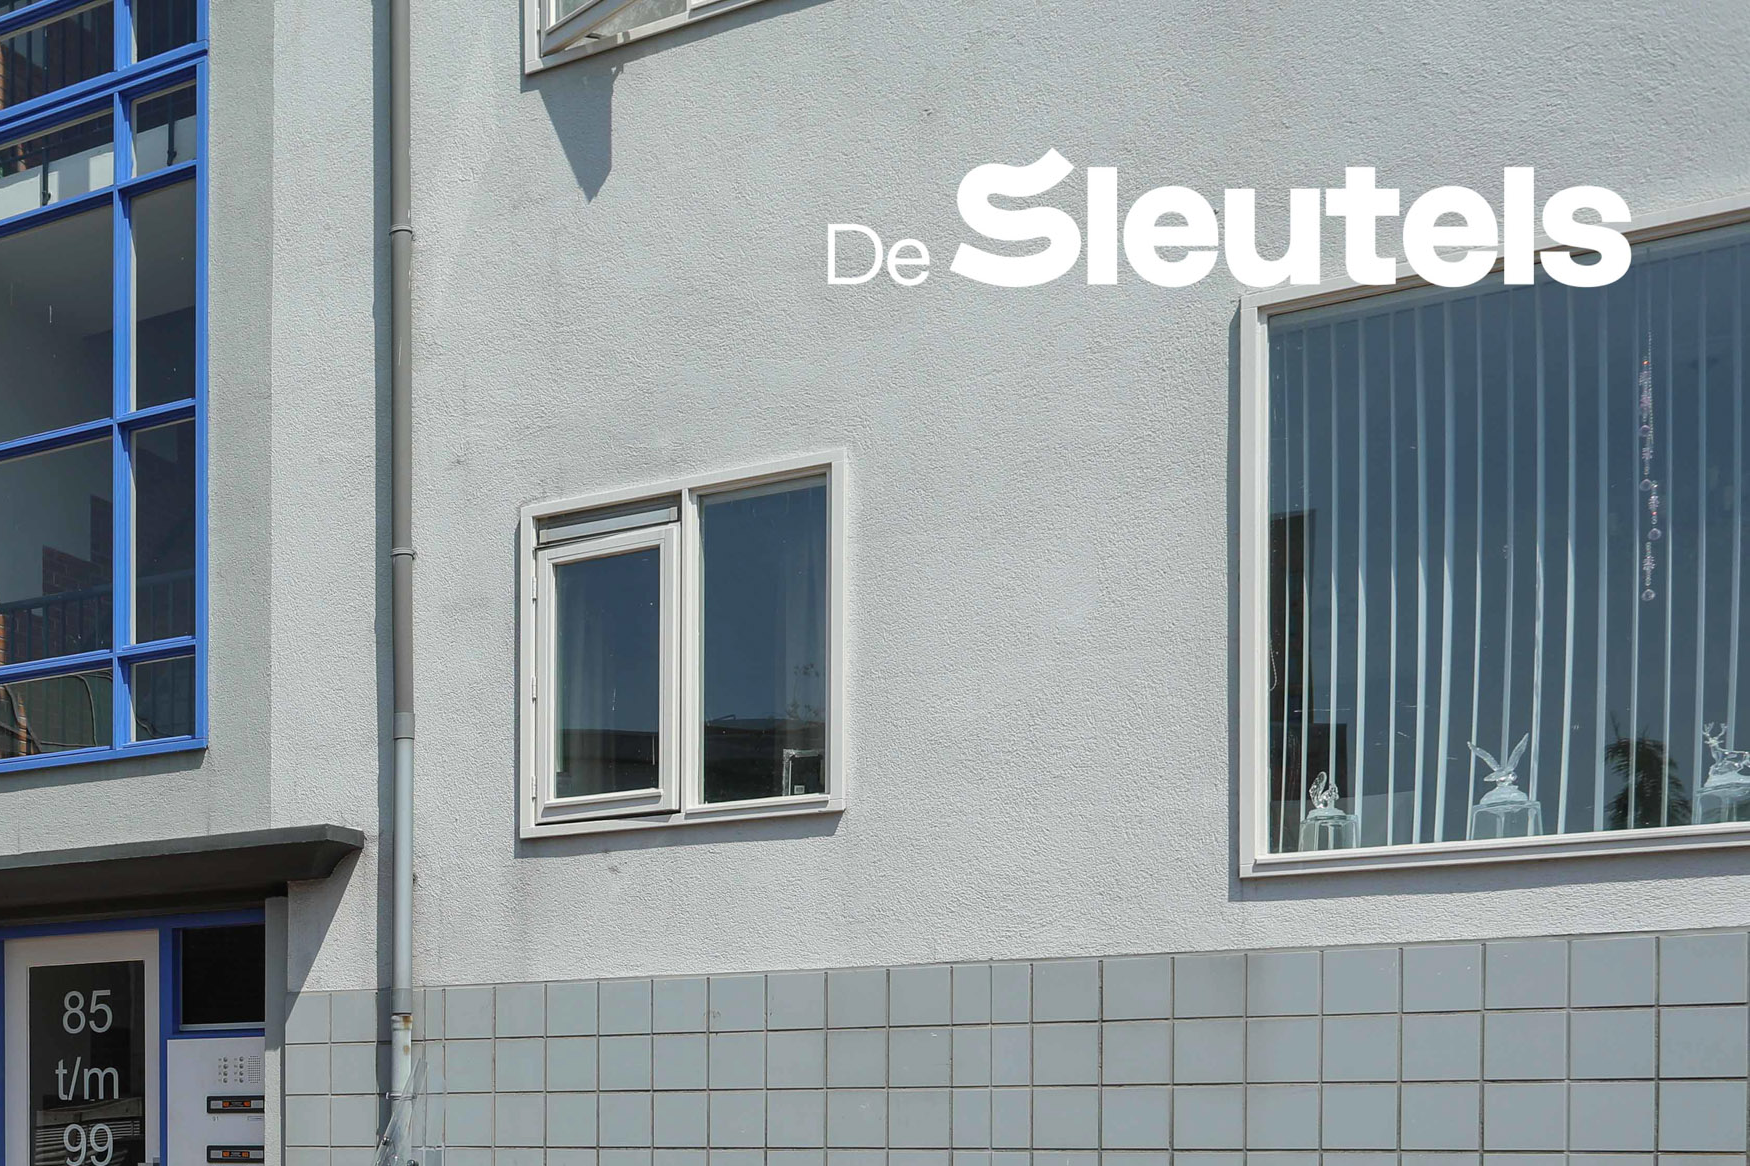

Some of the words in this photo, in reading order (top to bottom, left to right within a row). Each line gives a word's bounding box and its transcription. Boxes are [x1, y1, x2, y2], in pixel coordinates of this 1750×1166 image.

[62, 989, 113, 1034] 85
[54, 1056, 120, 1101] t/m
[63, 1123, 114, 1166] 99
